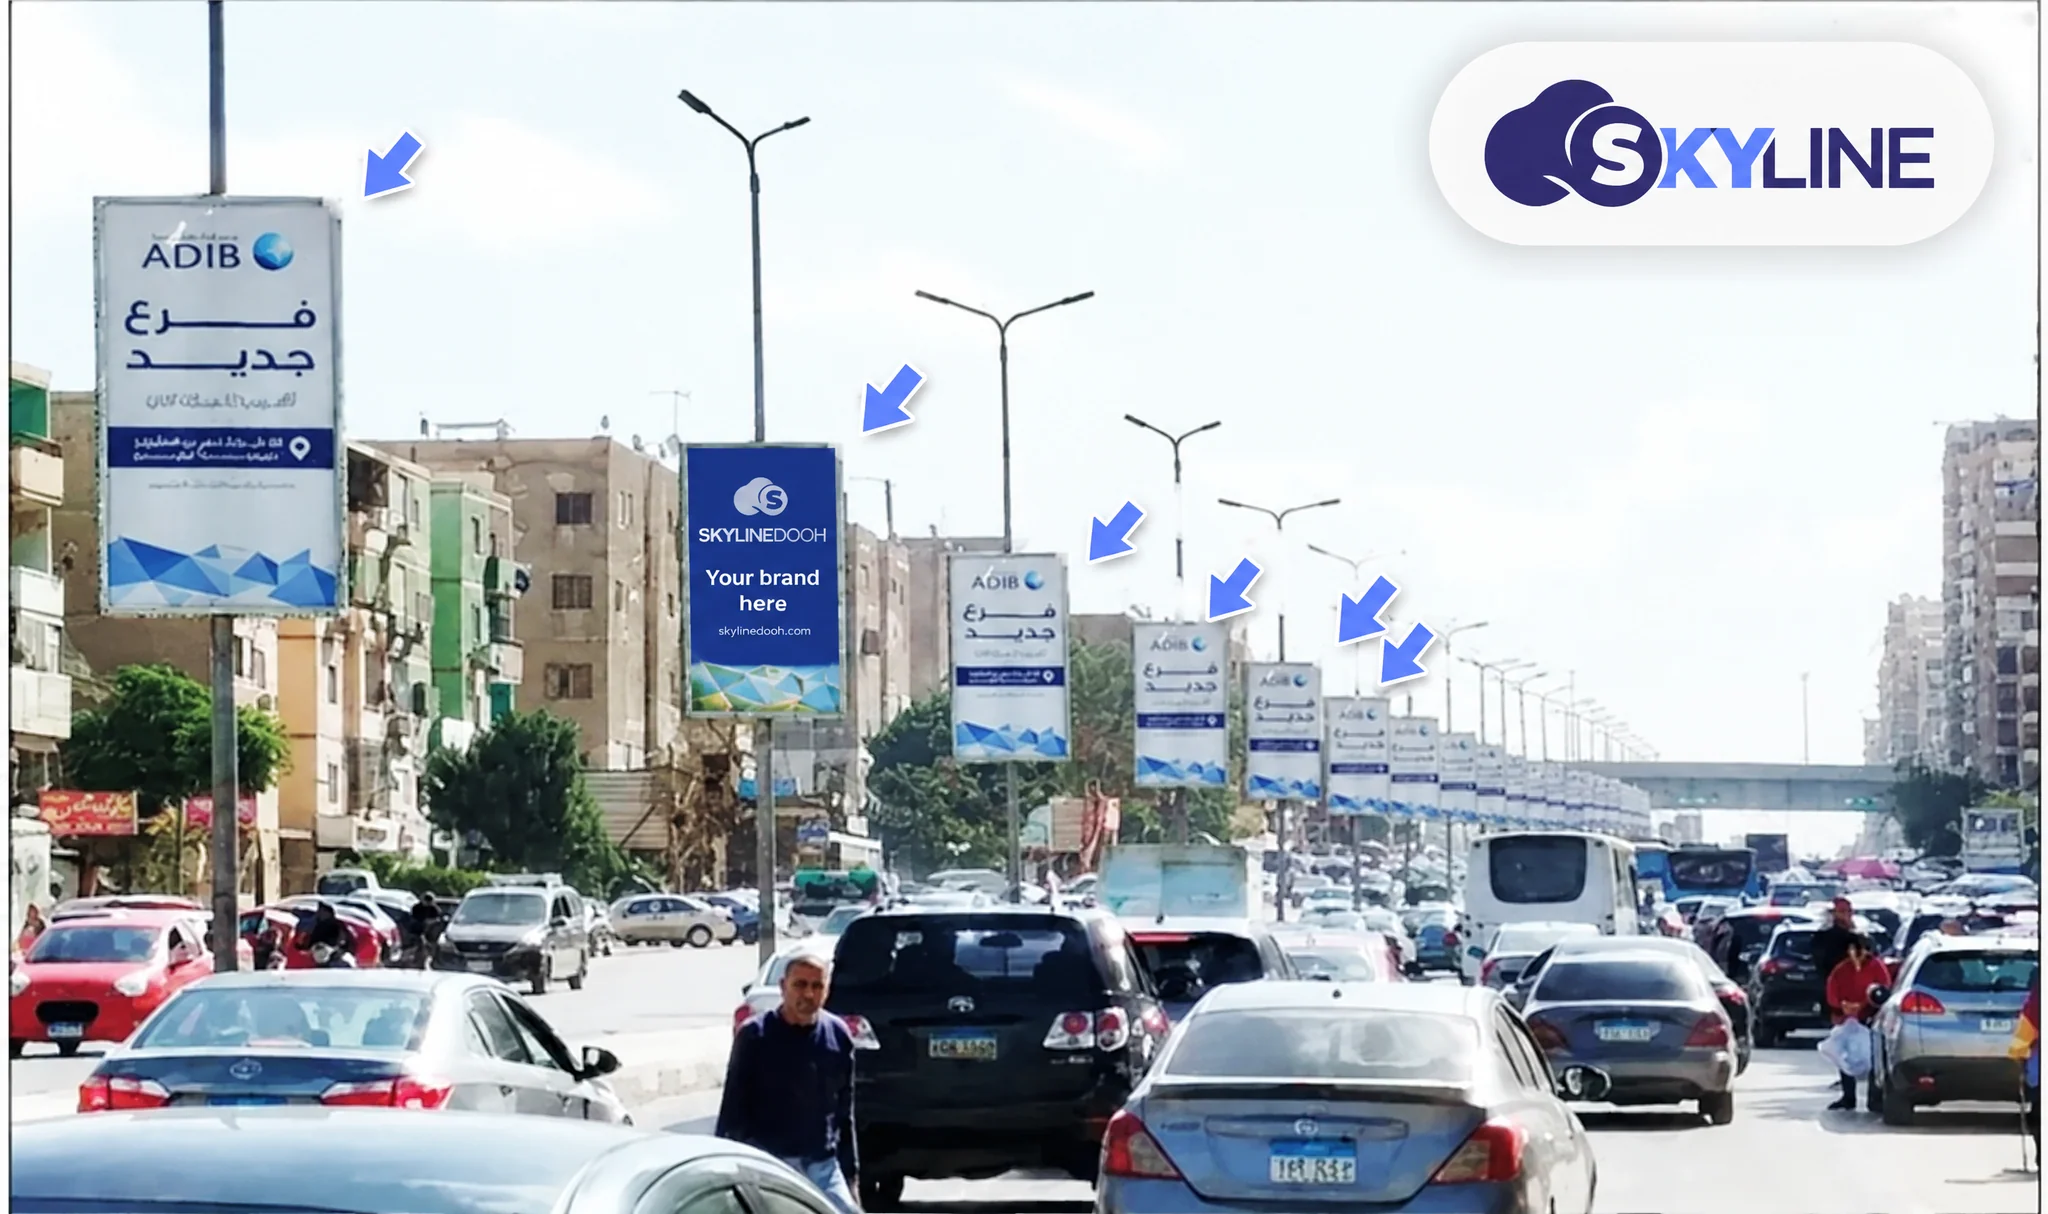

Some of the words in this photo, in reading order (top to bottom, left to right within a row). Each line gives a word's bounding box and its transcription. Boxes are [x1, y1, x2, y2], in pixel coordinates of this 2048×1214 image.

[142, 243, 241, 269] ADIB
[124, 300, 317, 335] فرع
[126, 349, 316, 377] جديد
[698, 528, 827, 543] SKYLINEDOOH
[705, 569, 754, 586] Your
[760, 569, 820, 586] brand
[739, 595, 787, 612] here
[963, 603, 1056, 622] فرع
[718, 626, 811, 638] skylinedooh.com
[964, 627, 1056, 643] جديد
